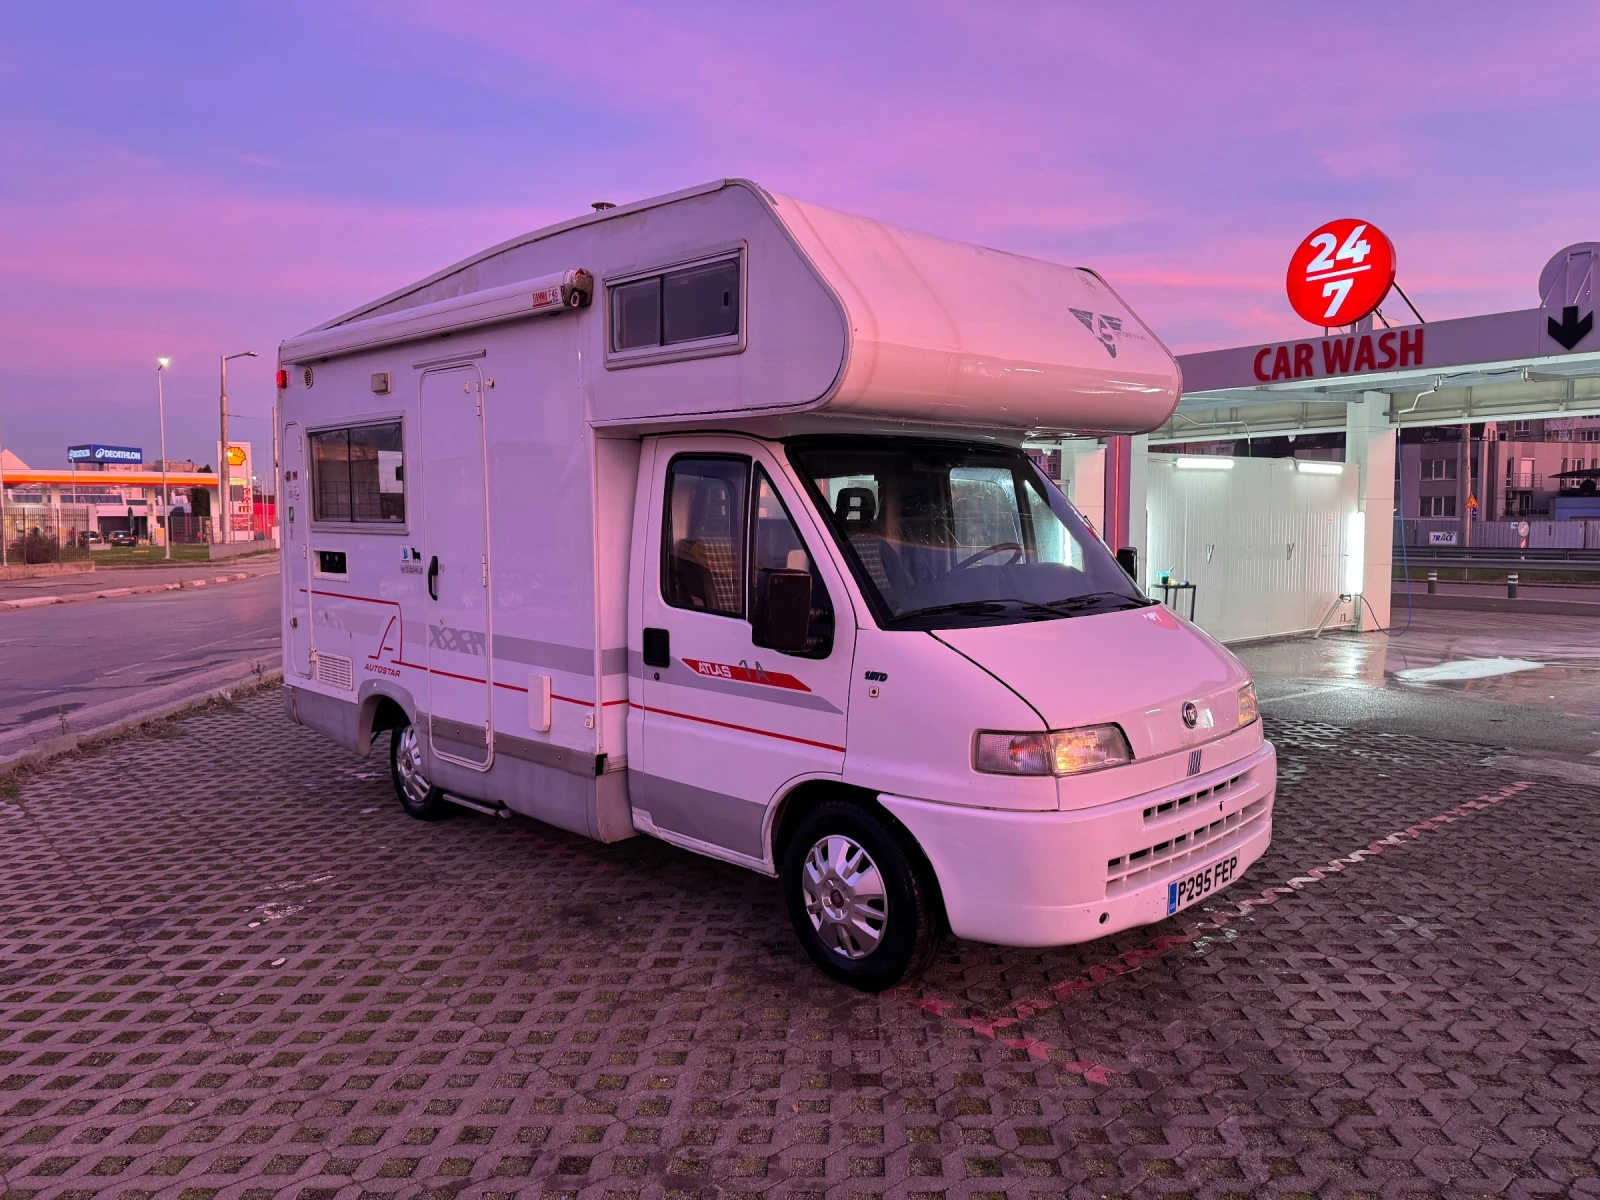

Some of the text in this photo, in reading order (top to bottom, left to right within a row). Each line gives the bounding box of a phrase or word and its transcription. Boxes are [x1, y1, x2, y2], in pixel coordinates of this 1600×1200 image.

[1306, 224, 1371, 273] 24
[1322, 278, 1354, 318] 7
[1253, 328, 1424, 382] CAR WASH
[104, 449, 141, 460] DECATHLON
[364, 663, 401, 678] AUTOSTAR
[698, 661, 732, 678] ATLAS
[1177, 856, 1238, 907] P295 FEP
